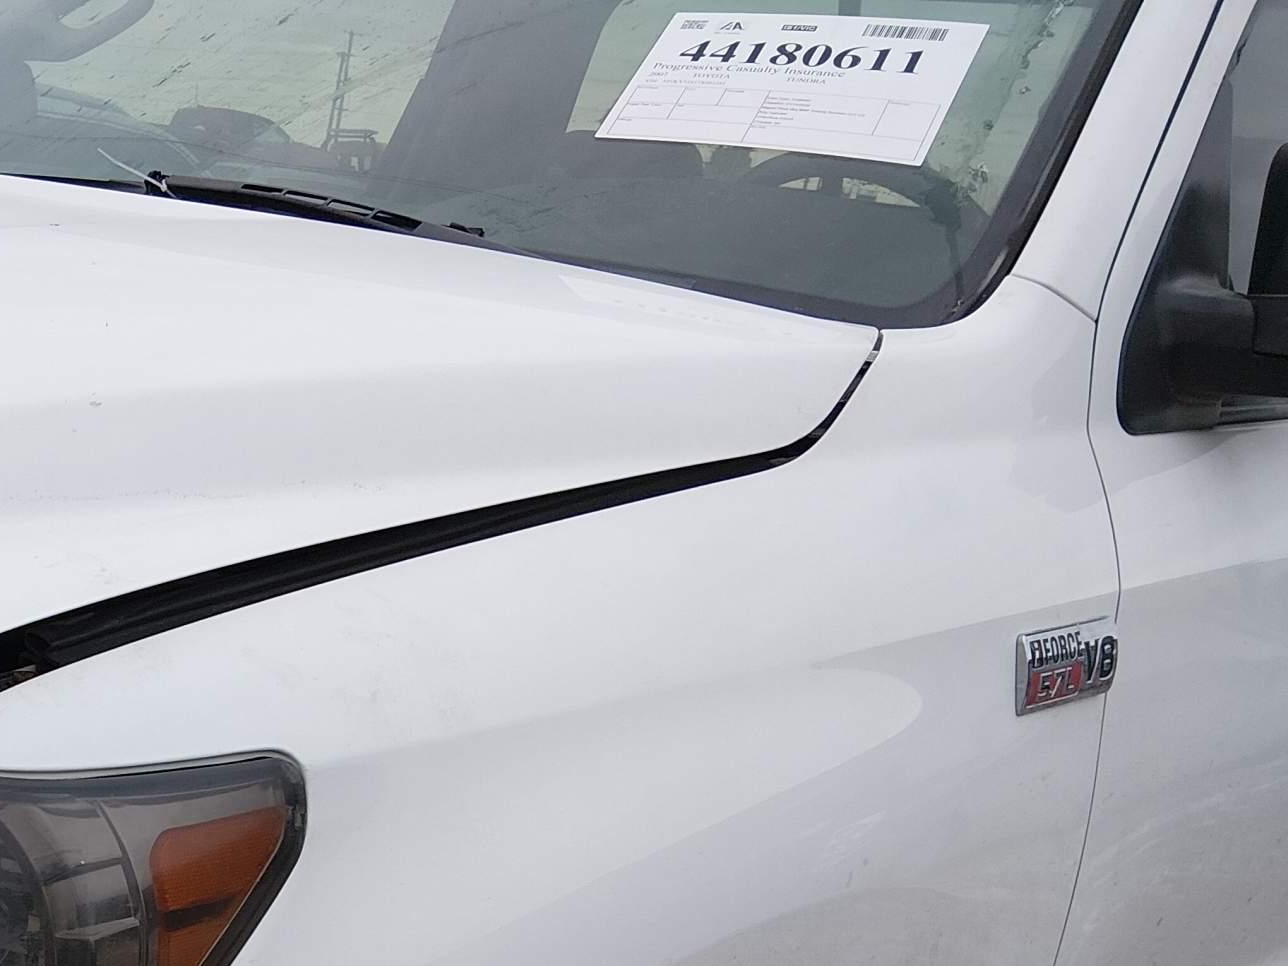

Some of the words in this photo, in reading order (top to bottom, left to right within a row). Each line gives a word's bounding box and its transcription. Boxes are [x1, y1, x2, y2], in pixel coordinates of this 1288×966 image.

[653, 62, 723, 72] Progressive
[726, 64, 779, 75] Casualty
[784, 67, 846, 78] Insurance
[679, 39, 925, 75] 44180611
[786, 77, 826, 85] TUNDRA
[1084, 635, 1119, 684] V8
